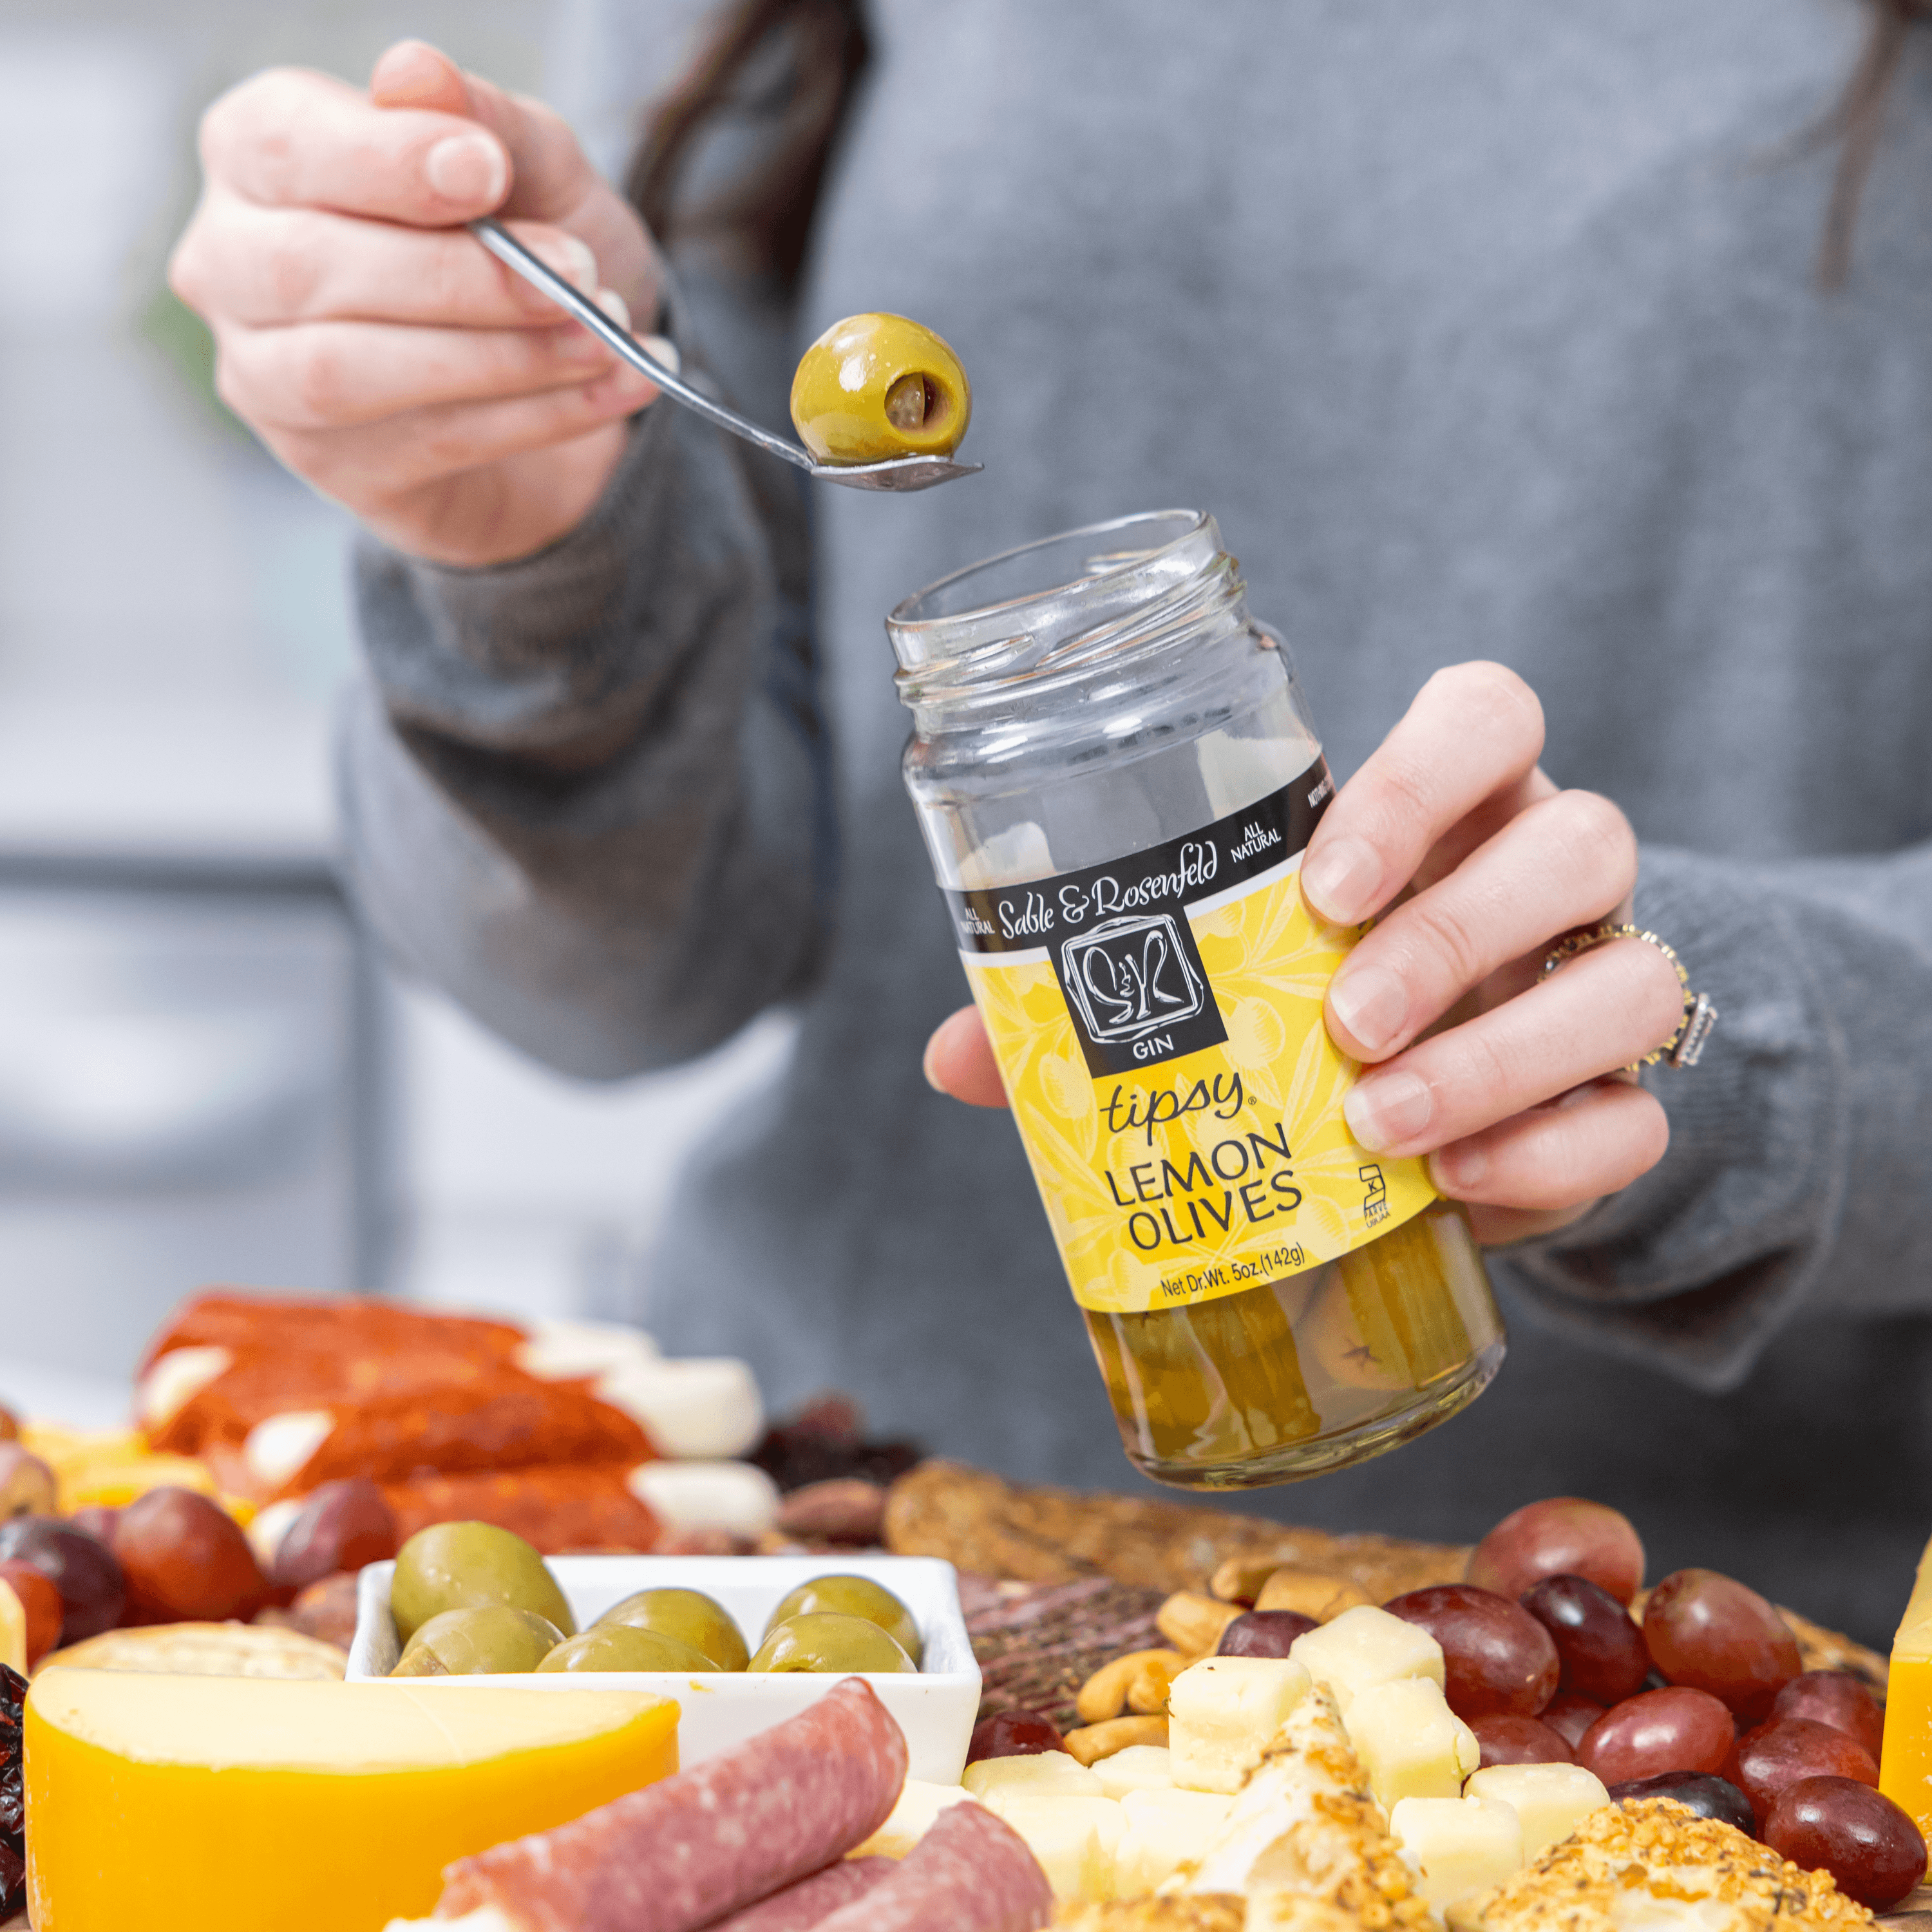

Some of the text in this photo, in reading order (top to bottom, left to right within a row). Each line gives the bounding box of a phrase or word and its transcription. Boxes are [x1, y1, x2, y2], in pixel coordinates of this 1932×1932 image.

[1231, 828, 1282, 863] NATURAL
[1244, 821, 1264, 842] ALL
[998, 840, 1217, 939] Sable & Rosenfeld
[960, 920, 996, 934] NATURAL
[965, 907, 980, 920] ALL
[1132, 1034, 1175, 1060] GIN
[1104, 1122, 1292, 1206] LEMON
[1129, 1170, 1302, 1250] OLIVES
[1160, 1276, 1186, 1298] Net
[1186, 1267, 1230, 1293] Dr.Wt.
